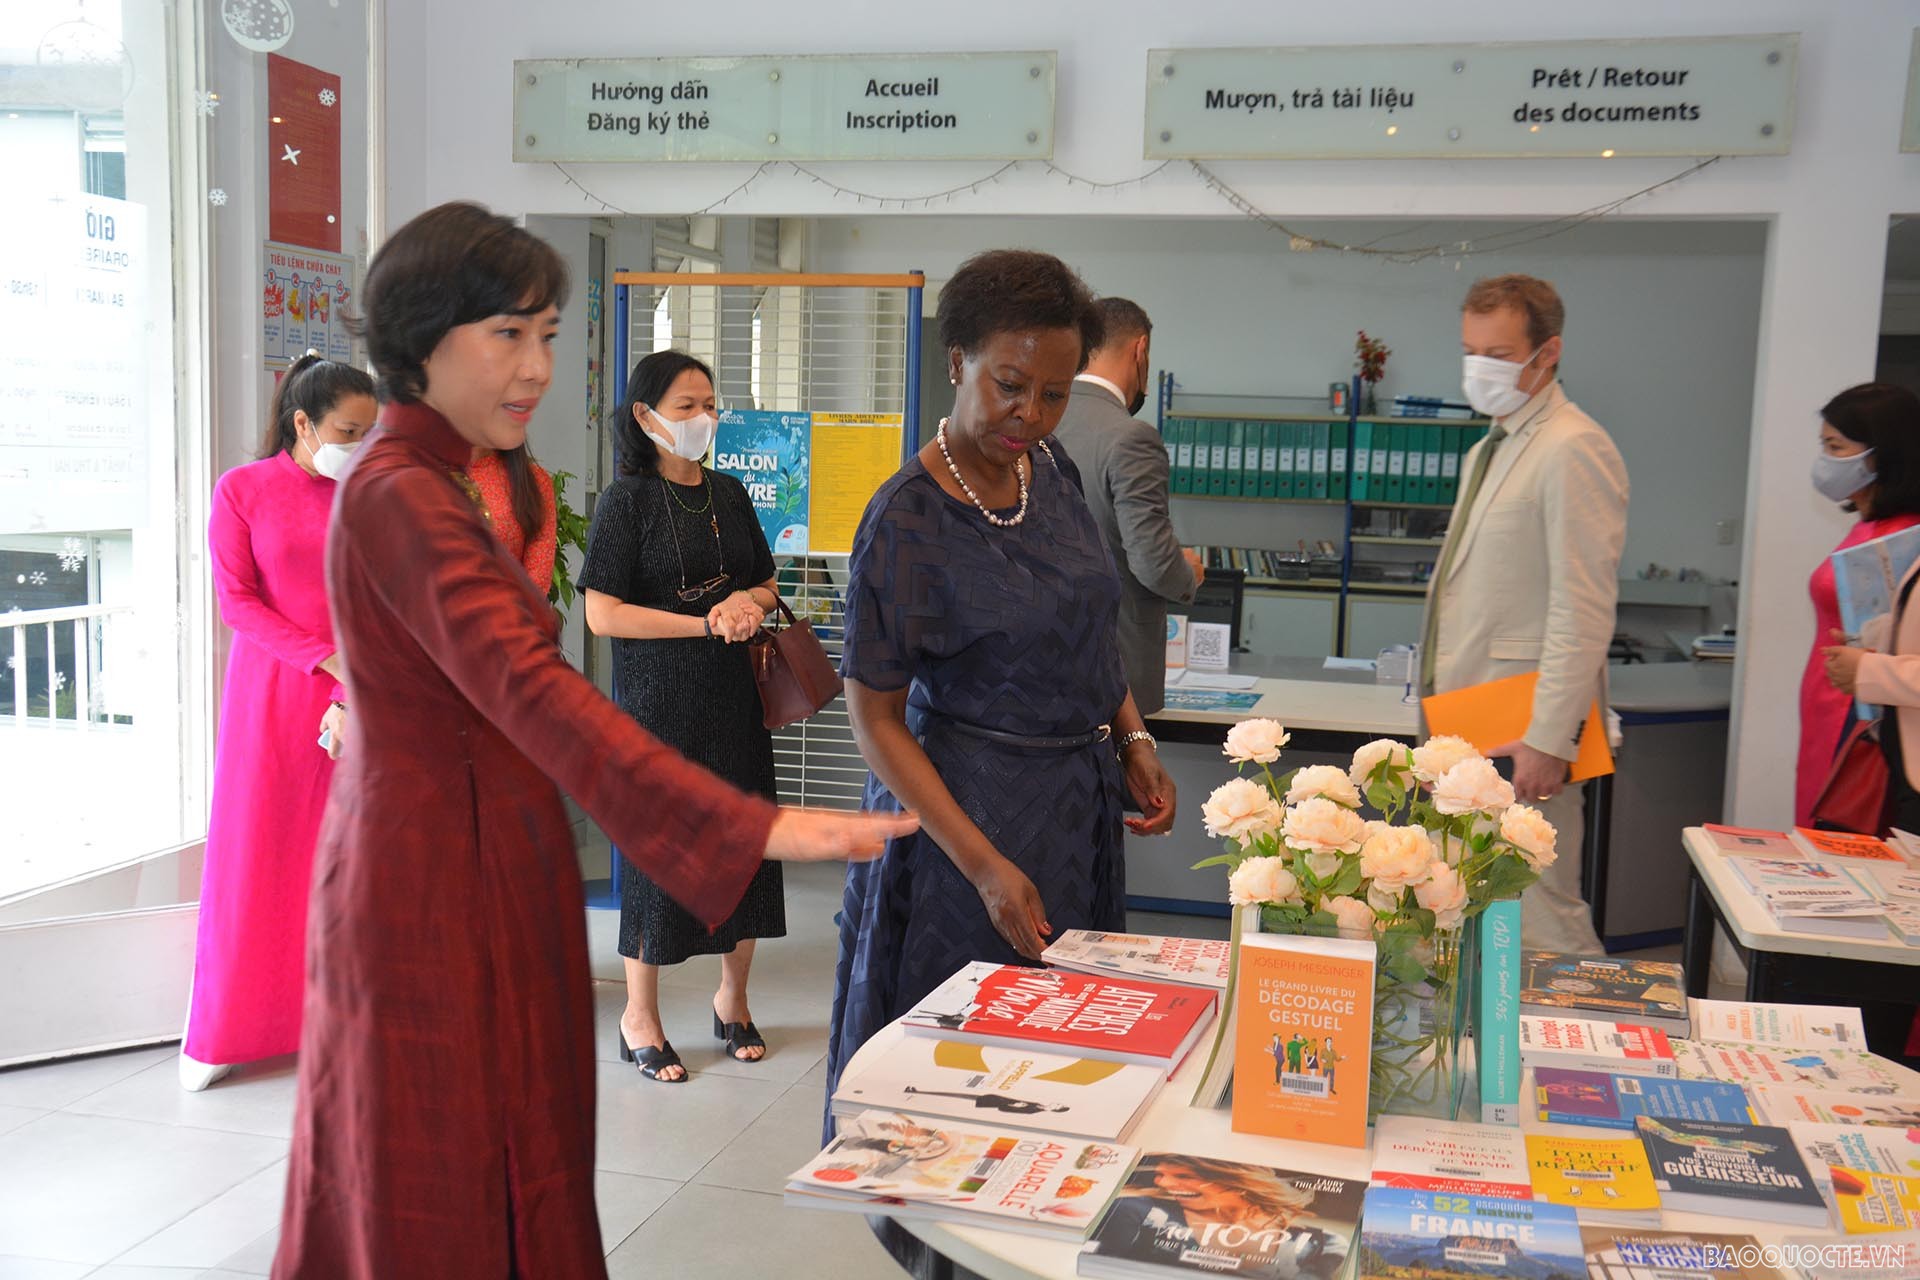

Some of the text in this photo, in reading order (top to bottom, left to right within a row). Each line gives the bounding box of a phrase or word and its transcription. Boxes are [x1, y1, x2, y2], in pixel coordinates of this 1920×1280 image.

[865, 77, 938, 97] Accueil
[1532, 68, 1582, 88] Prêt
[1604, 67, 1688, 87] Retour
[592, 80, 708, 104] Hướng dẫn
[1206, 88, 1414, 114] Mượn, trả tài liệu
[846, 110, 957, 133] Inscription
[1514, 102, 1700, 122] des documents
[587, 111, 710, 135] Đăng ký thẻ
[717, 453, 778, 471] SALON
[743, 471, 756, 482] du
[1254, 956, 1365, 978] JOSEPH MESSINGER
[1259, 978, 1356, 998] LE GRAND LIVRE DU
[1067, 985, 1158, 1035] AFFICHES
[1259, 989, 1355, 1016] DÉCODAGE
[1269, 1008, 1343, 1031] GESTUEL
[998, 1141, 1068, 1210] AQUARELLE
[1663, 1161, 1804, 1189] GUÉRISSEUR
[1704, 1159, 1760, 1172] POUVOIRS
[1763, 1166, 1776, 1174] DE
[1295, 1180, 1344, 1194] THILLEMAN
[1316, 1178, 1344, 1188] LAURY
[1434, 1195, 1470, 1214] 52
[1475, 1200, 1534, 1213] escapades
[1476, 1208, 1534, 1221] nature
[1410, 1214, 1536, 1244] FRANCE
